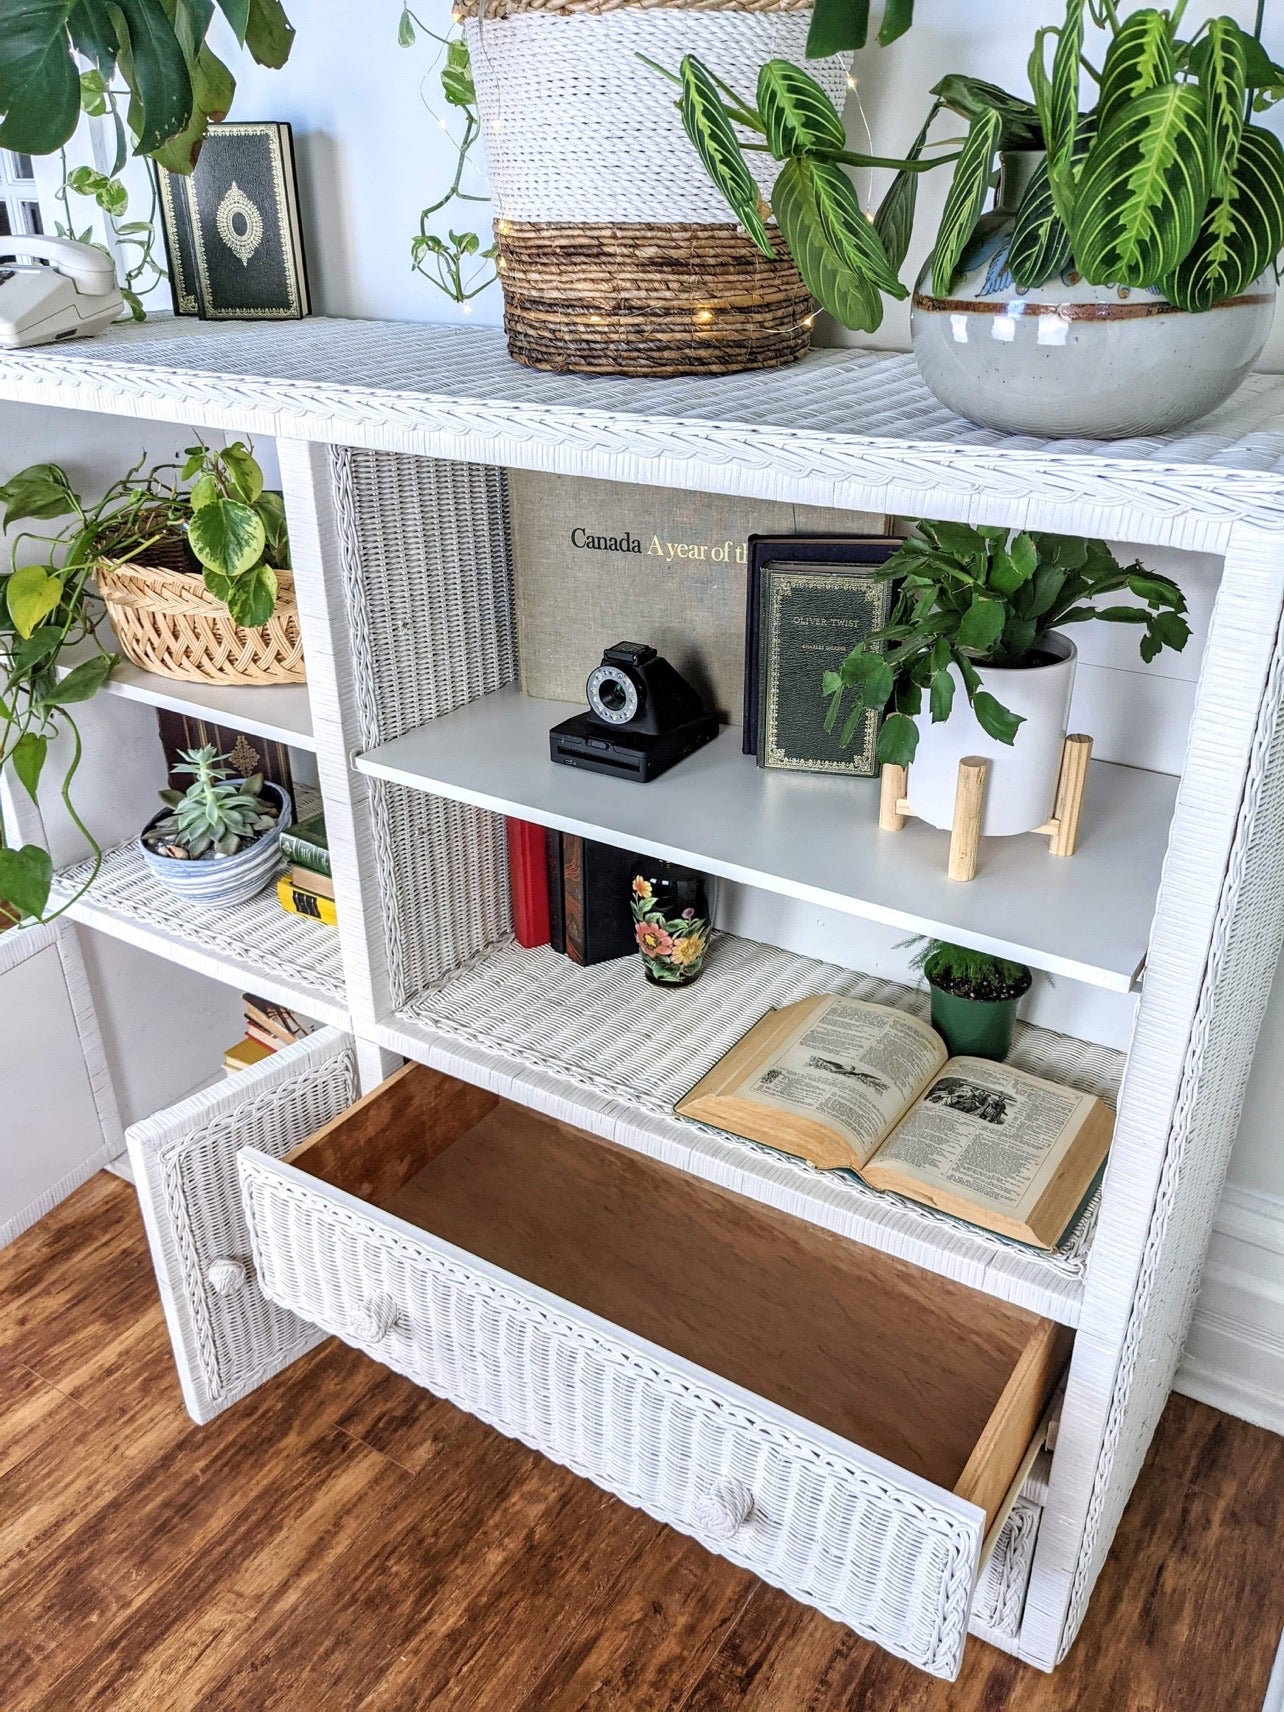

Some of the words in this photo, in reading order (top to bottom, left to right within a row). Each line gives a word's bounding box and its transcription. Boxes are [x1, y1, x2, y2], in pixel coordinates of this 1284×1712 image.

[571, 527, 642, 554] Canada
[647, 535, 664, 556] A
[666, 542, 708, 562] year
[711, 541, 733, 563] of
[793, 616, 828, 626] OLIVER
[830, 618, 860, 628] TWIST
